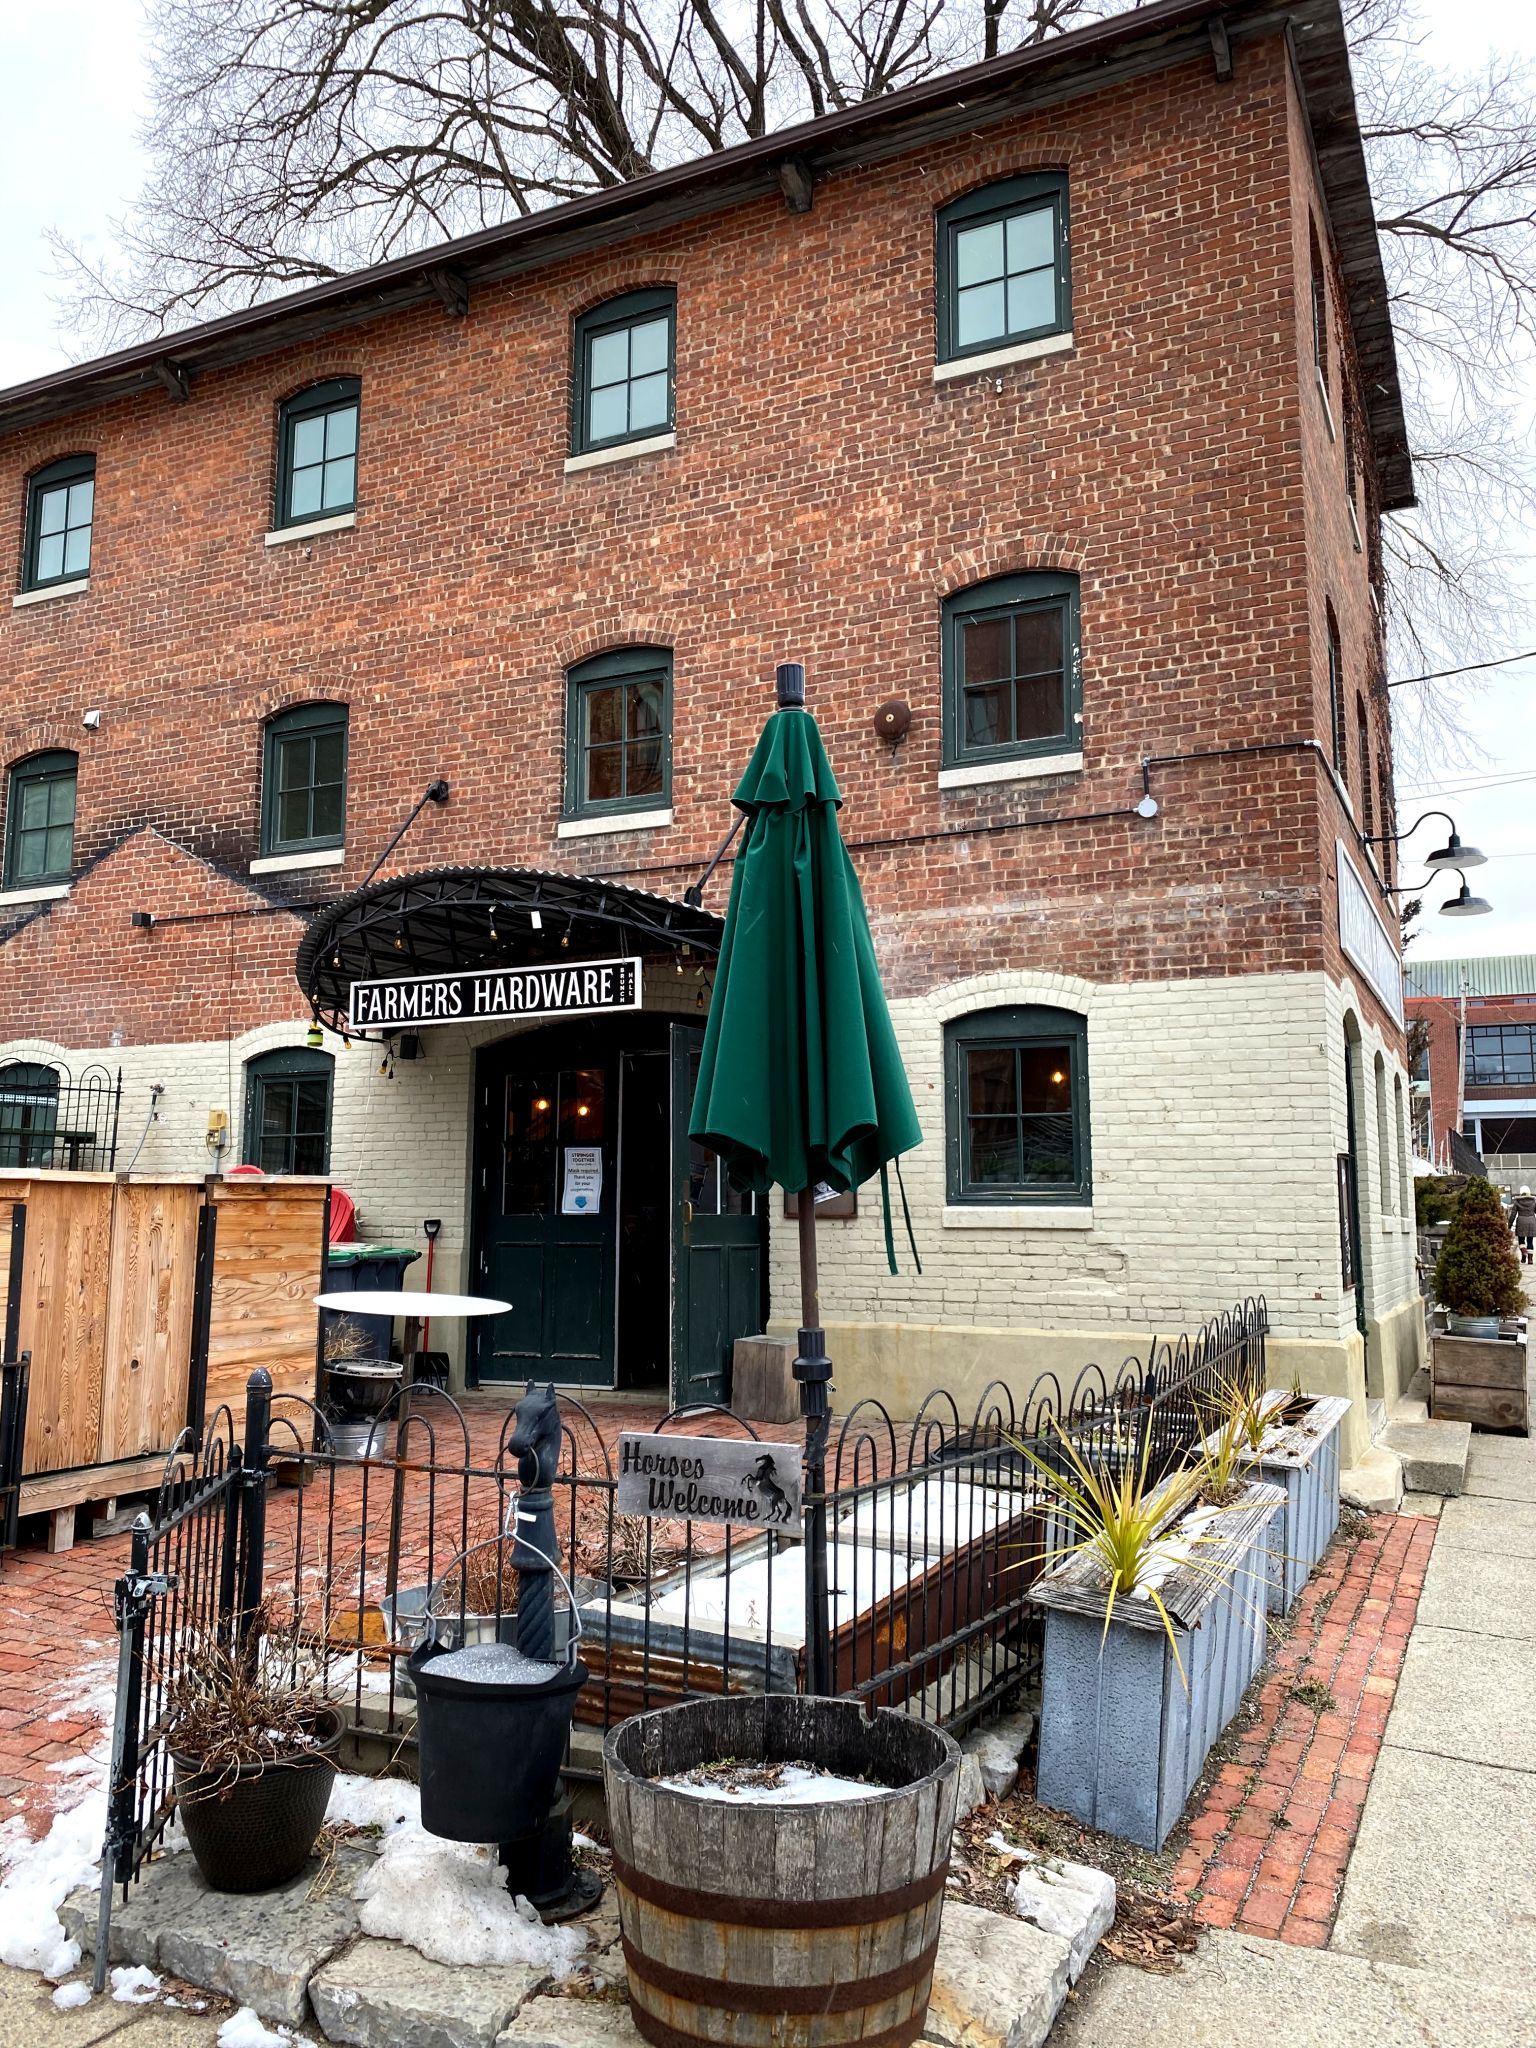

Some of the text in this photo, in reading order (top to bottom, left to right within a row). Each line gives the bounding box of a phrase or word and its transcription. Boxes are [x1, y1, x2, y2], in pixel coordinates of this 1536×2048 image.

[357, 968, 614, 1021] FARMERS HARDWARE
[622, 1441, 704, 1479] Horses
[648, 1477, 760, 1521] Welcome
